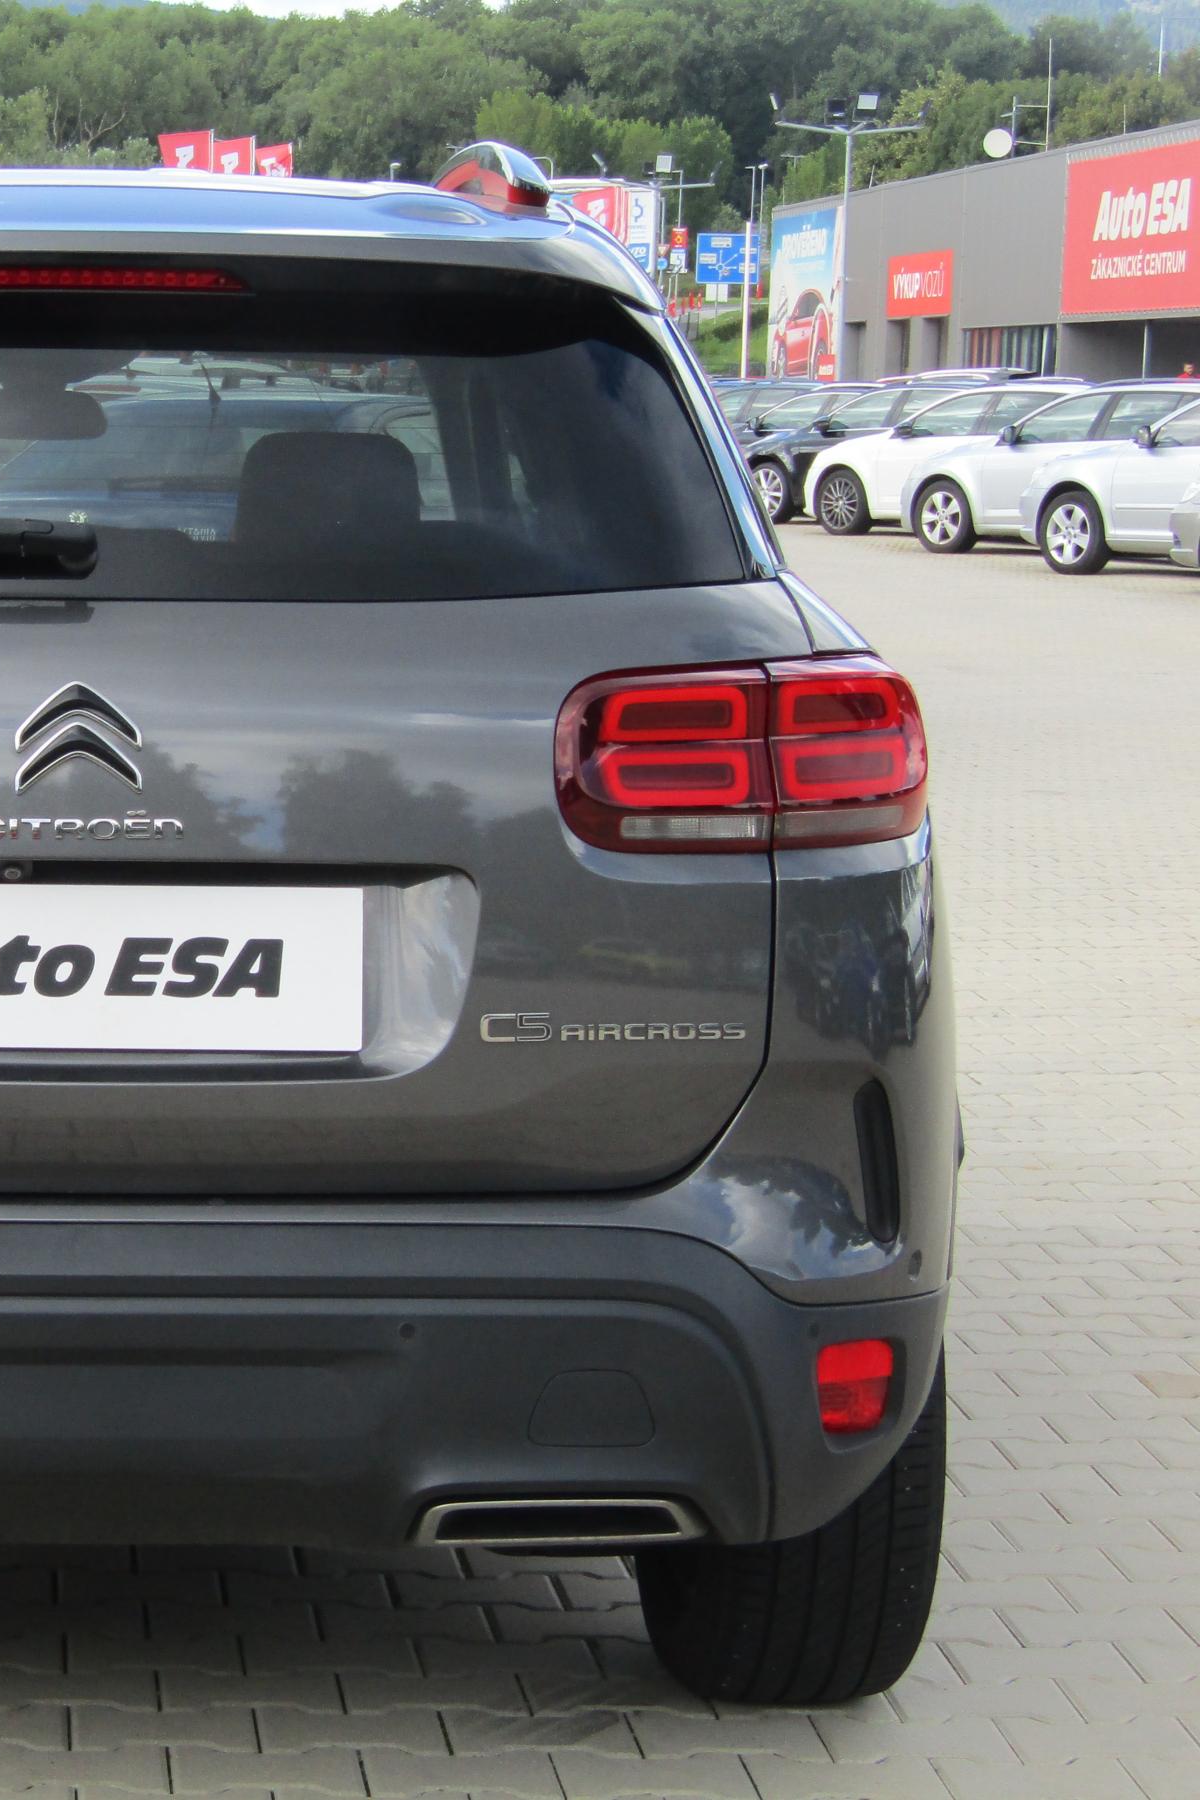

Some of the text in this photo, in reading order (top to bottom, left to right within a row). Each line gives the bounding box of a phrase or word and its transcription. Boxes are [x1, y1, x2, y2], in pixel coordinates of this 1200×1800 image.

[1093, 178, 1192, 242] Auto ESA
[1090, 249, 1186, 280] ZÁKAZNICKÉ CENTRUM
[893, 266, 920, 300] VÝKUP
[104, 937, 284, 998] ESA
[480, 1013, 746, 1042] C5 AIRCROSS
